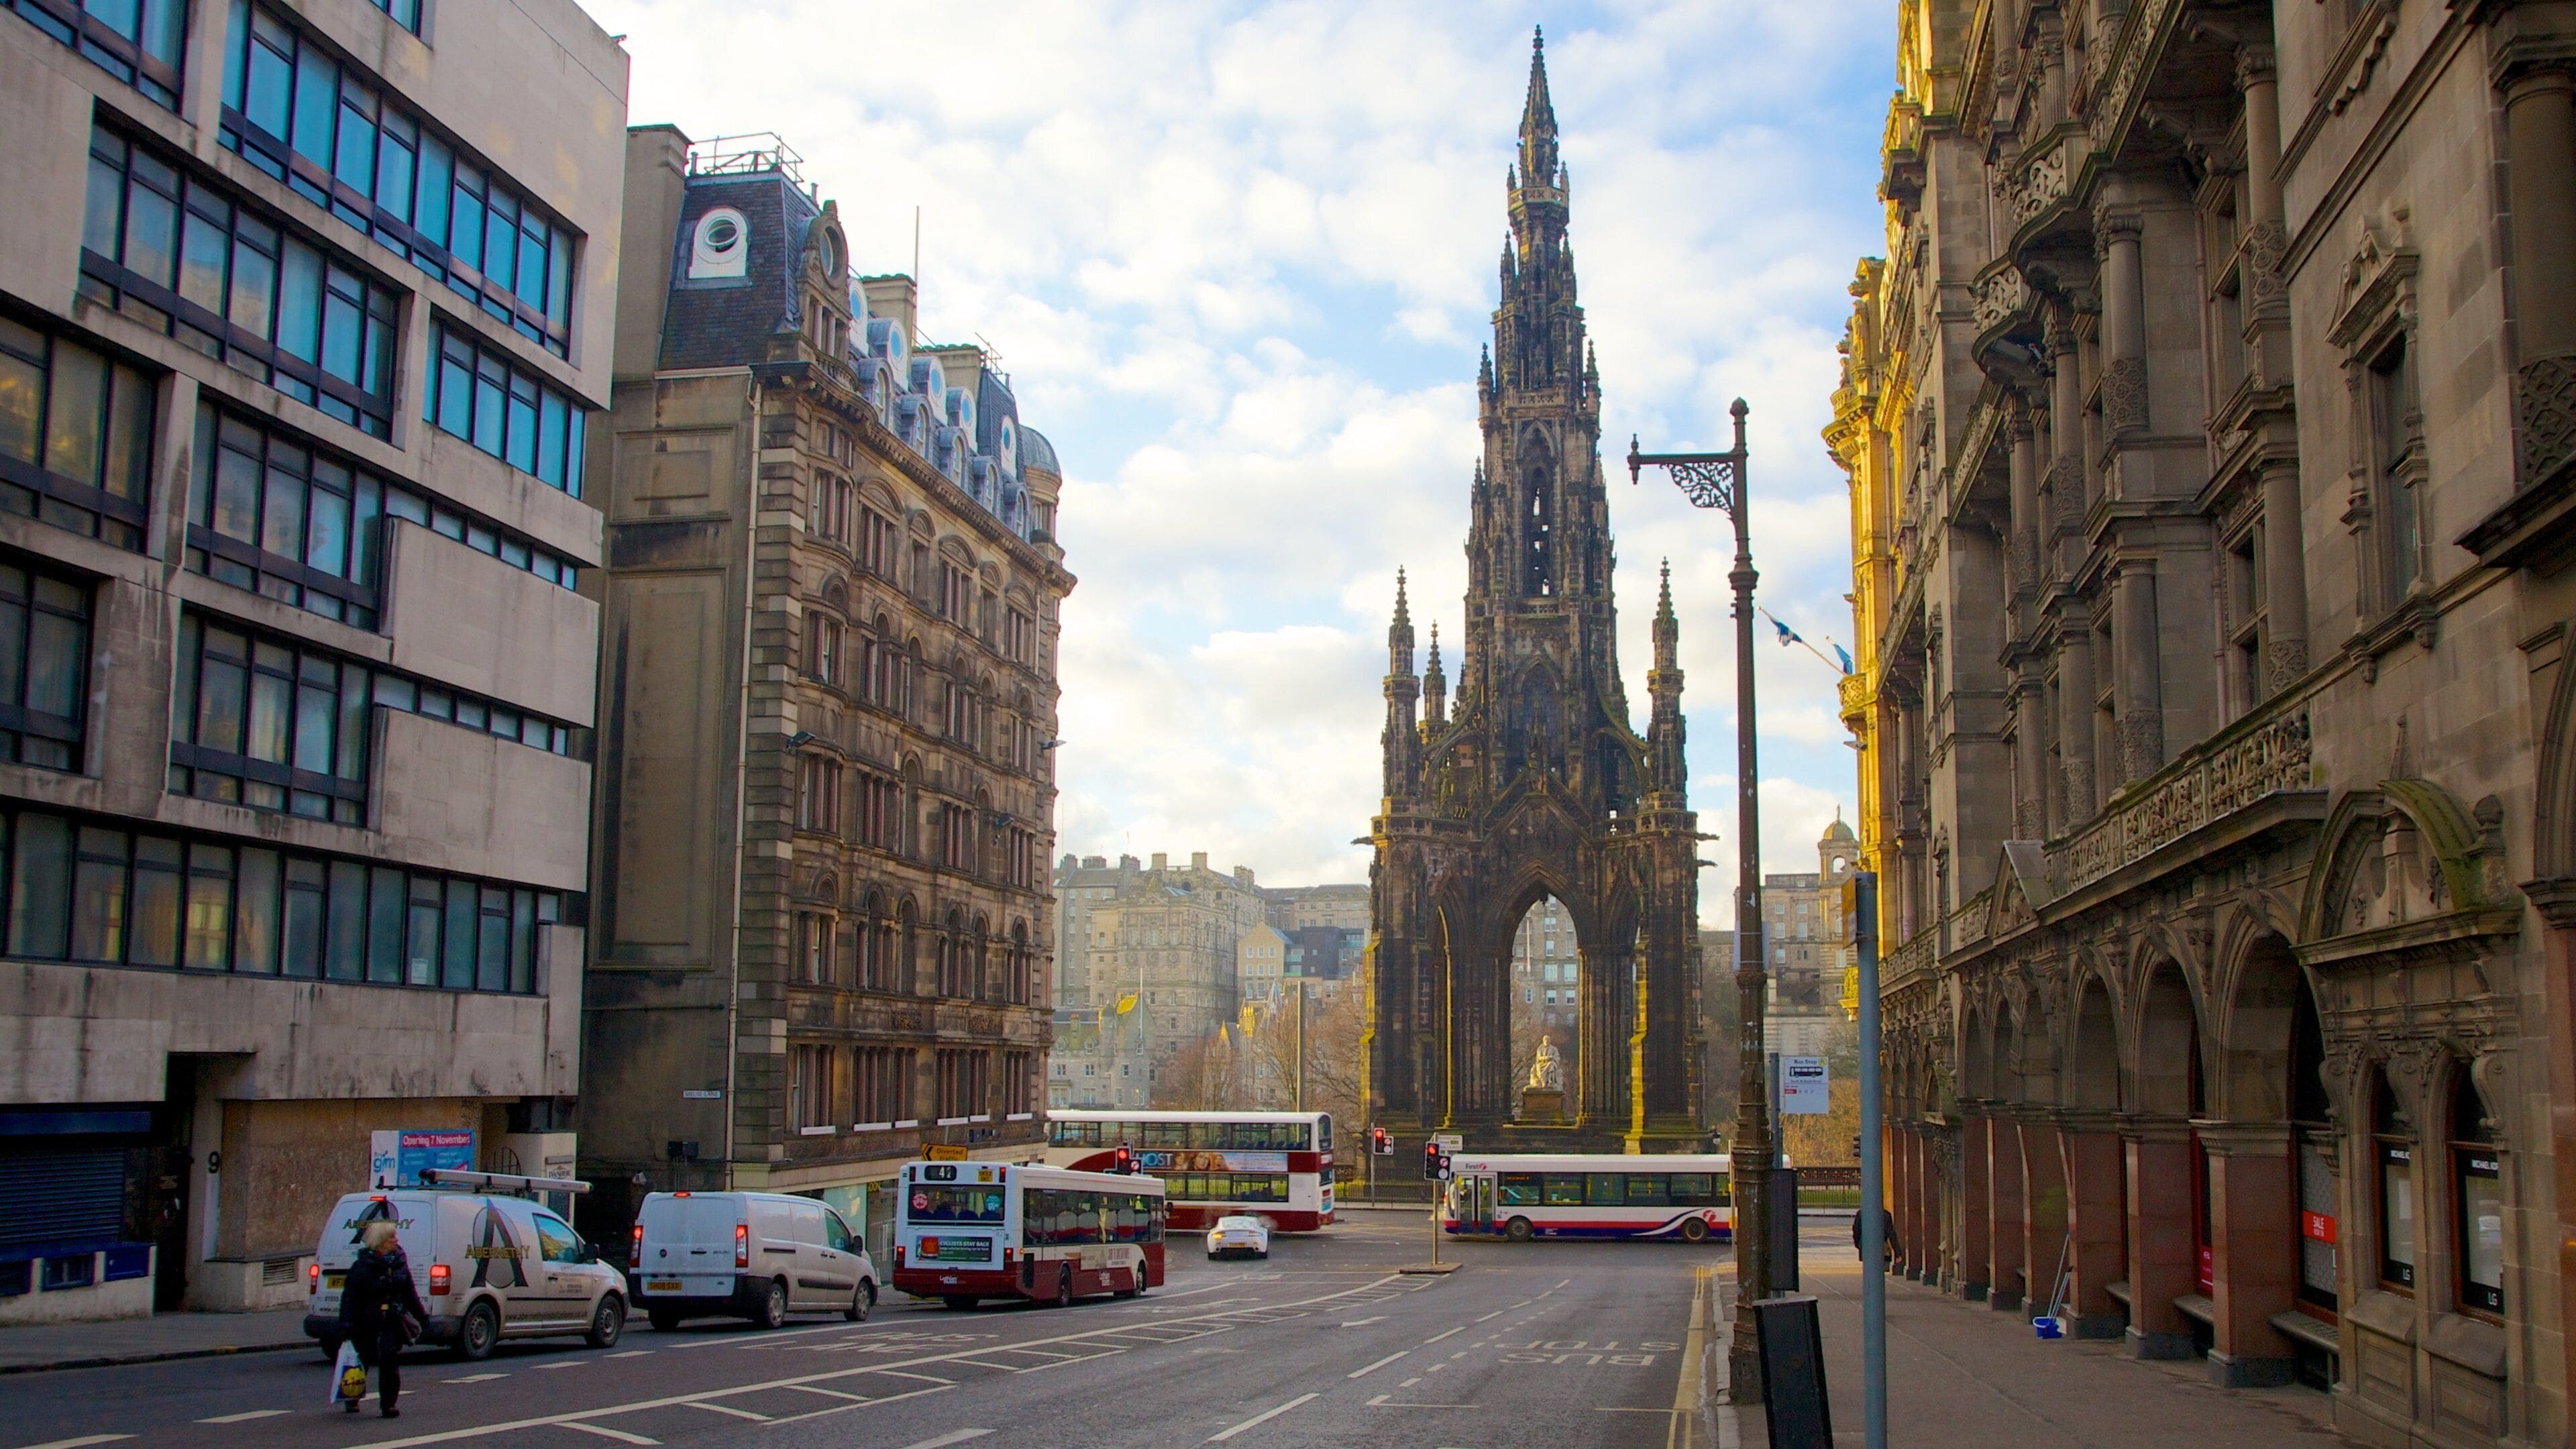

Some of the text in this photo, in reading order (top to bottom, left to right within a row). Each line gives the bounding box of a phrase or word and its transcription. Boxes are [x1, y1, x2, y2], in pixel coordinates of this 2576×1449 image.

[403, 1135, 430, 1147] Opening
[431, 1135, 435, 1144] 7
[209, 1151, 220, 1173] 9
[465, 1244, 531, 1258] ABERNETHY
[1494, 1340, 1680, 1351] STOP
[1498, 1352, 1655, 1366] BUS
